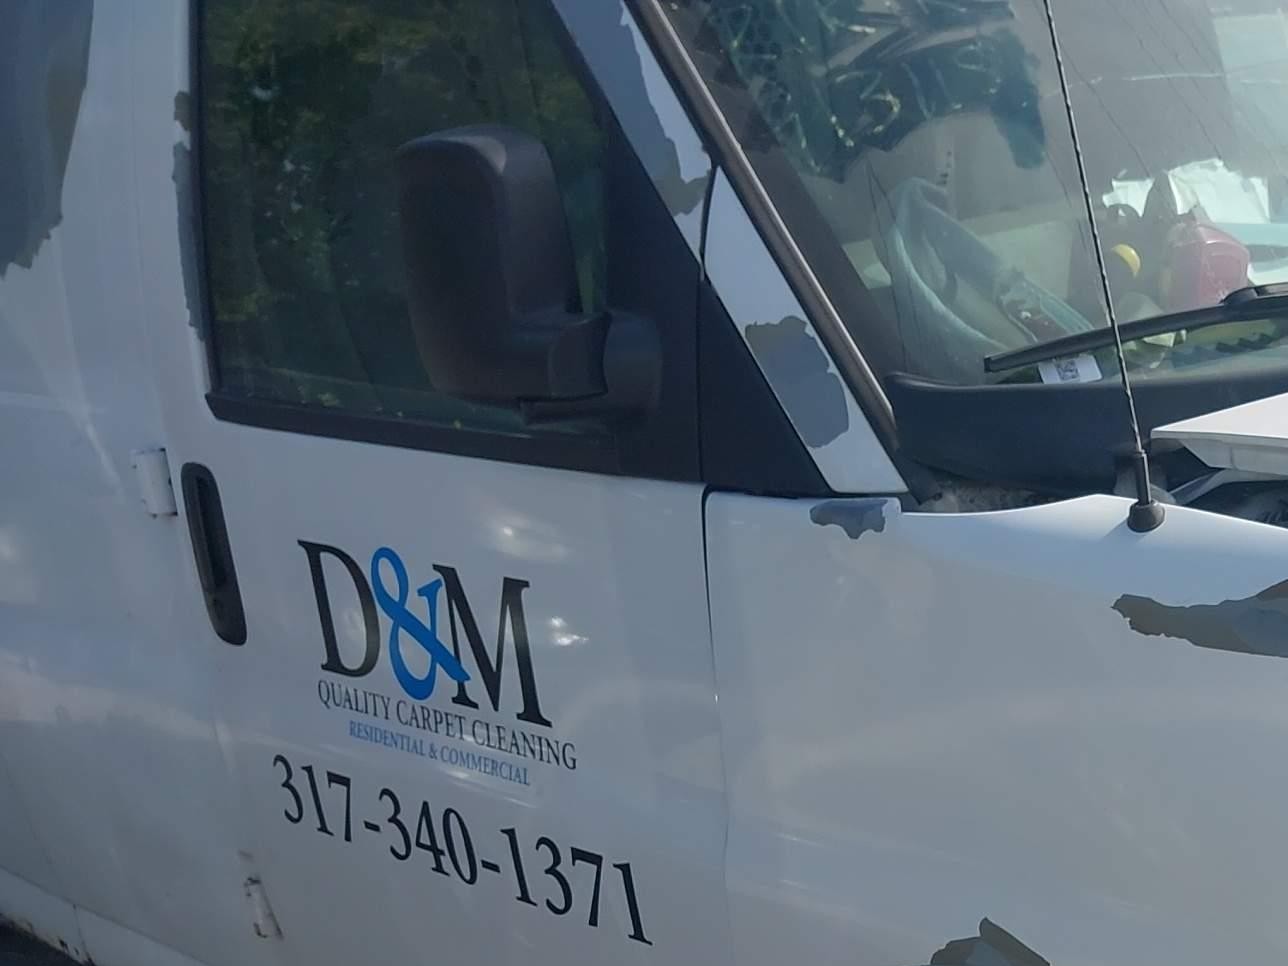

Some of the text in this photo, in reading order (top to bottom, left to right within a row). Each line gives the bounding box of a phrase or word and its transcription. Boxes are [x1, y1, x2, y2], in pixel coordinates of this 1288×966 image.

[297, 539, 552, 728] D&M
[318, 679, 577, 770] QUALITY CARPET CLEANING
[349, 720, 531, 786] RESIDENTIAL & COMMERCIAL
[273, 754, 653, 946] 317-340-1371
